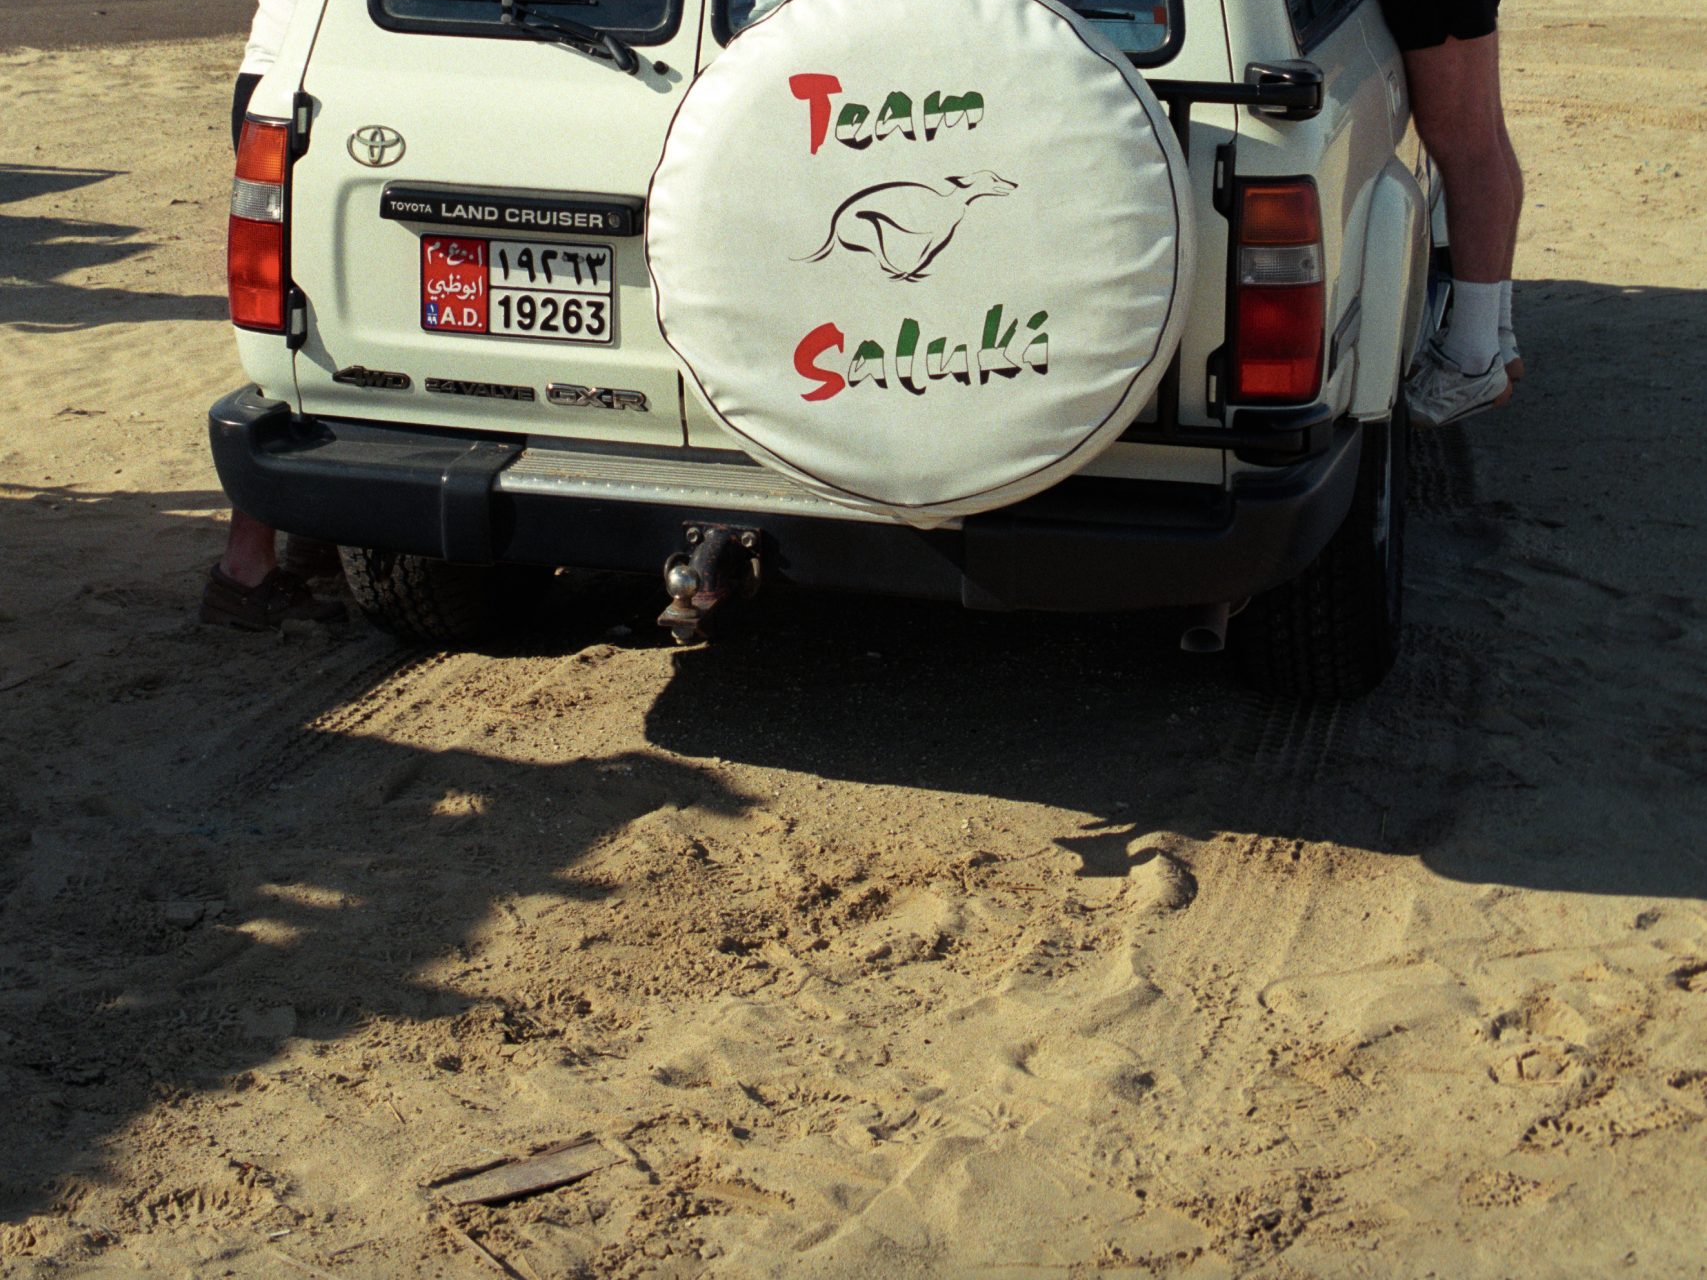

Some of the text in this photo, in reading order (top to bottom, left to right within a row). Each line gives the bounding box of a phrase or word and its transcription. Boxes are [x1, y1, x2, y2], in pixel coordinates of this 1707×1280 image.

[788, 72, 984, 155] Team
[390, 200, 604, 229] TOYOTA LAND CRUISER
[498, 247, 606, 286] ١٩٢٦٣
[427, 272, 483, 301] ابوظبي
[440, 306, 483, 328] A.D.
[498, 294, 605, 336] 19263
[793, 303, 1049, 402] Saluki
[333, 365, 411, 390] 4WD
[425, 377, 458, 395] 24
[459, 381, 535, 402] VALVE
